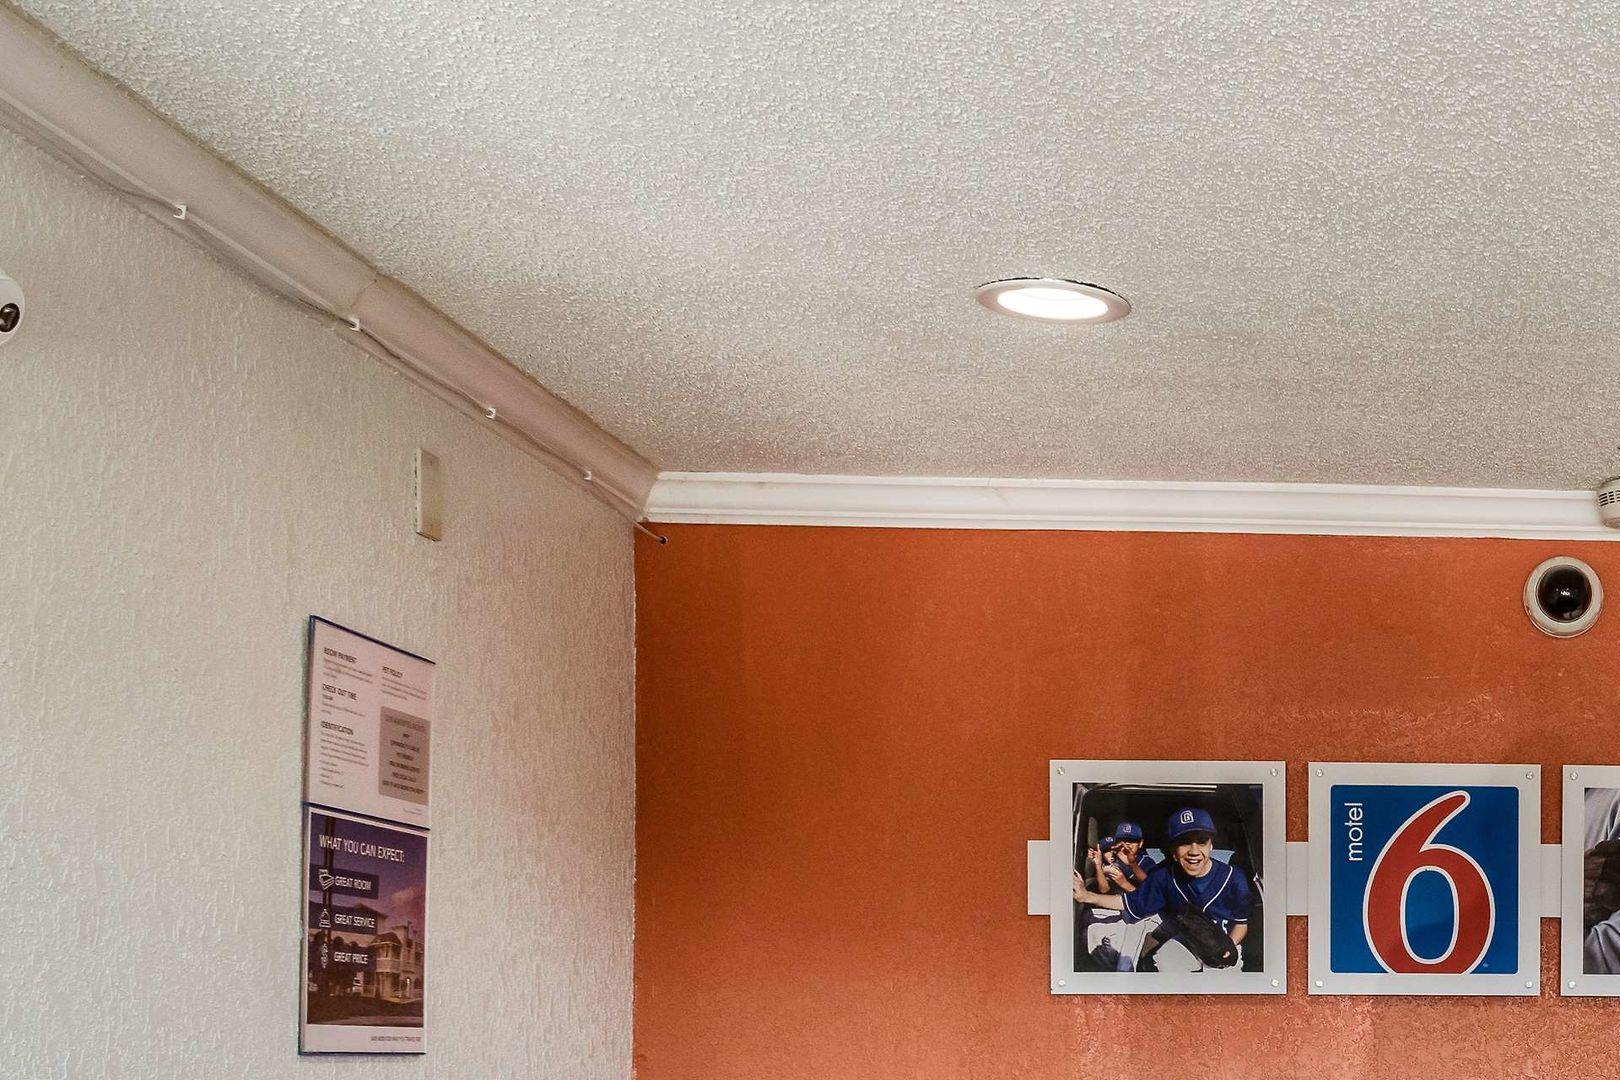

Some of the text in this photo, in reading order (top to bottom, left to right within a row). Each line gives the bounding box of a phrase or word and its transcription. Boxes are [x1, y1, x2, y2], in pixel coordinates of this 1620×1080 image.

[1344, 802, 1364, 862] motel
[318, 834, 405, 863] WHAT YOU CAN EXPECT:
[335, 875, 372, 890] GREAT ROOM
[1362, 790, 1496, 975] 6
[335, 914, 375, 928] GREAT SERVICE
[334, 952, 368, 964] GREAT PRICE
